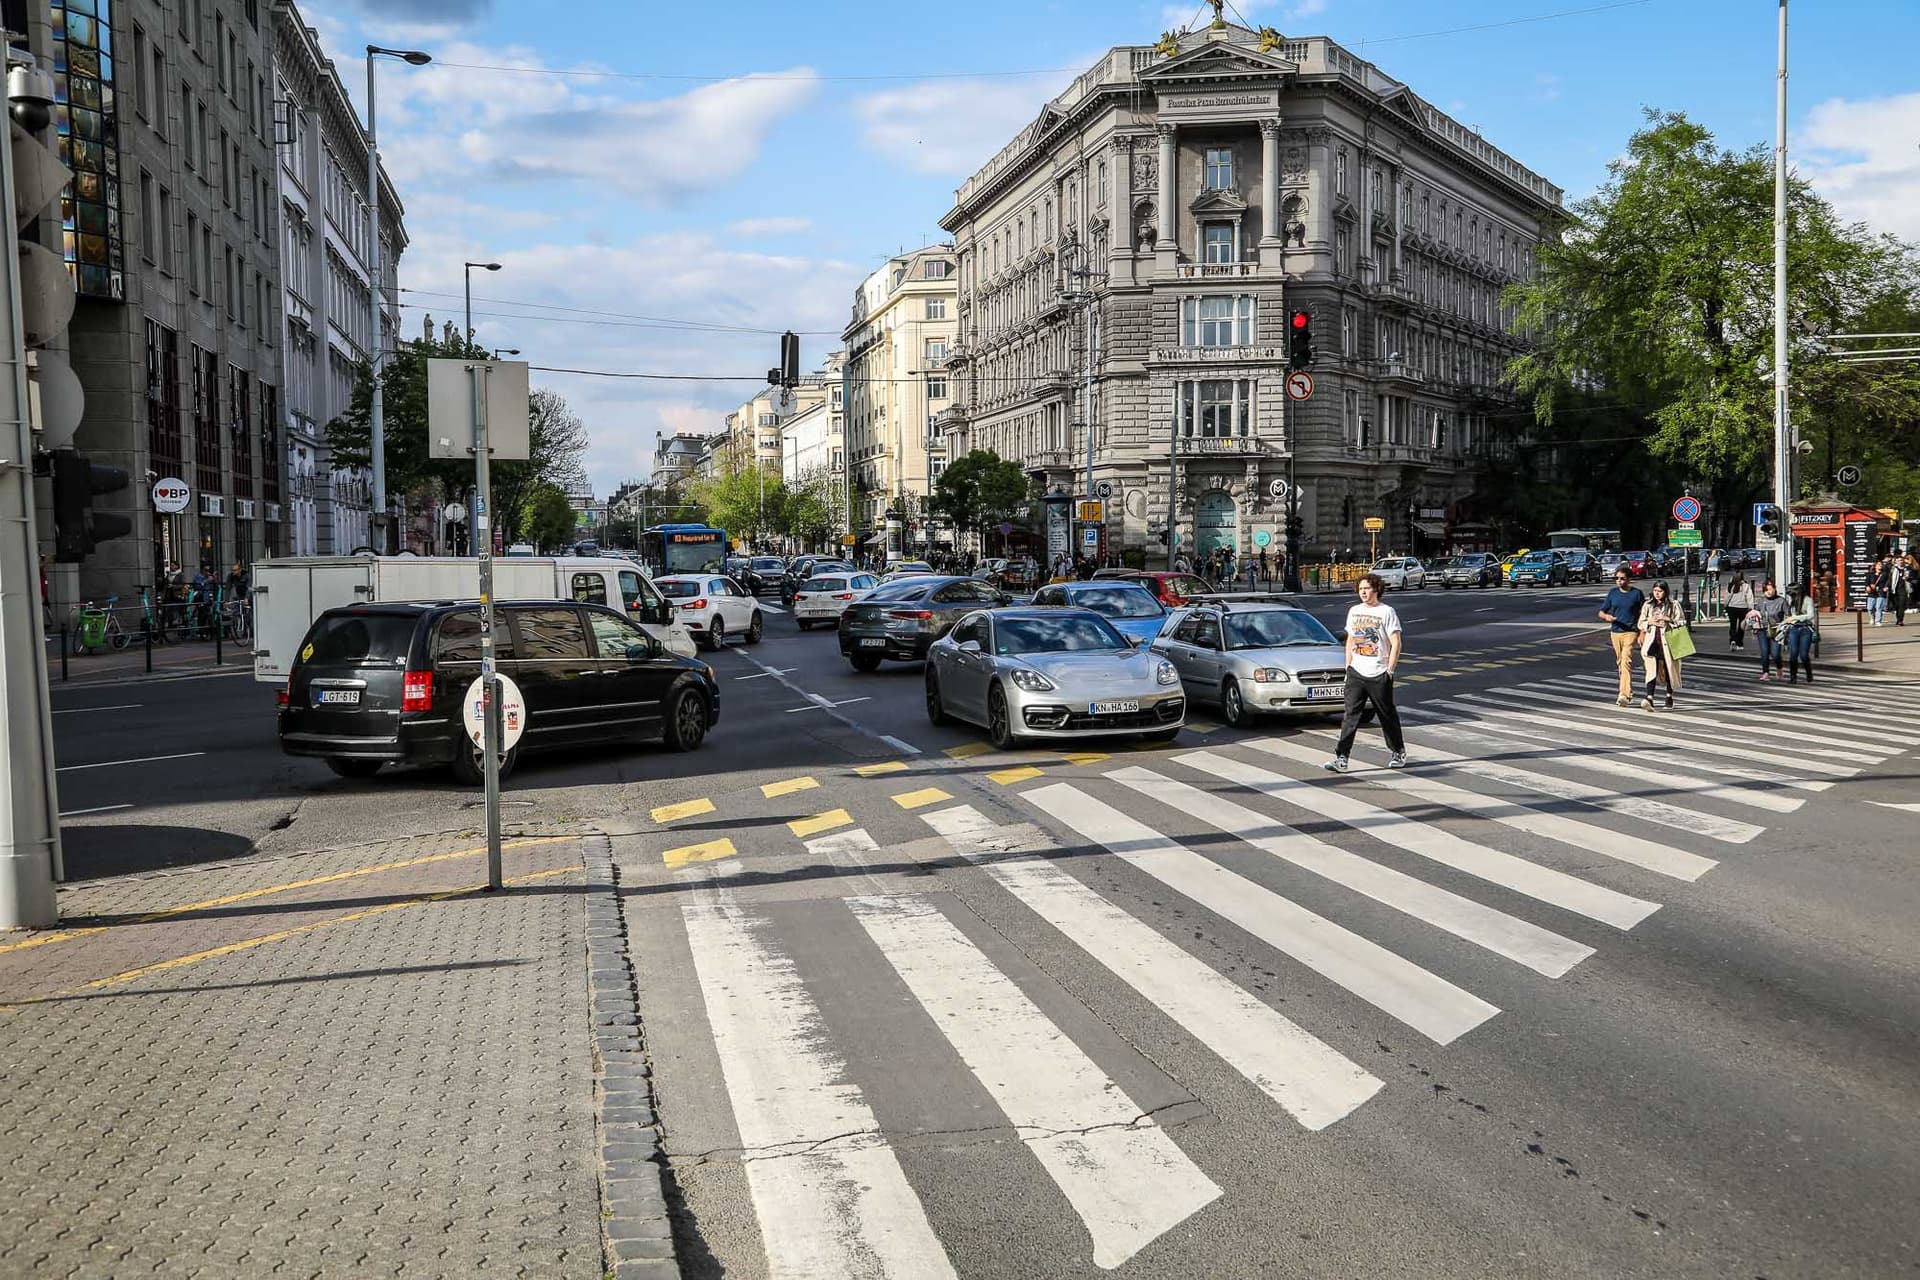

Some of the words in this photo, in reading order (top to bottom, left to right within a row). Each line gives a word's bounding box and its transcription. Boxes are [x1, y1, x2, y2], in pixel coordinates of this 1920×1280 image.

[170, 488, 188, 498] BP
[1801, 514, 1833, 522] FITZKEY
[1095, 703, 1107, 713] KN
